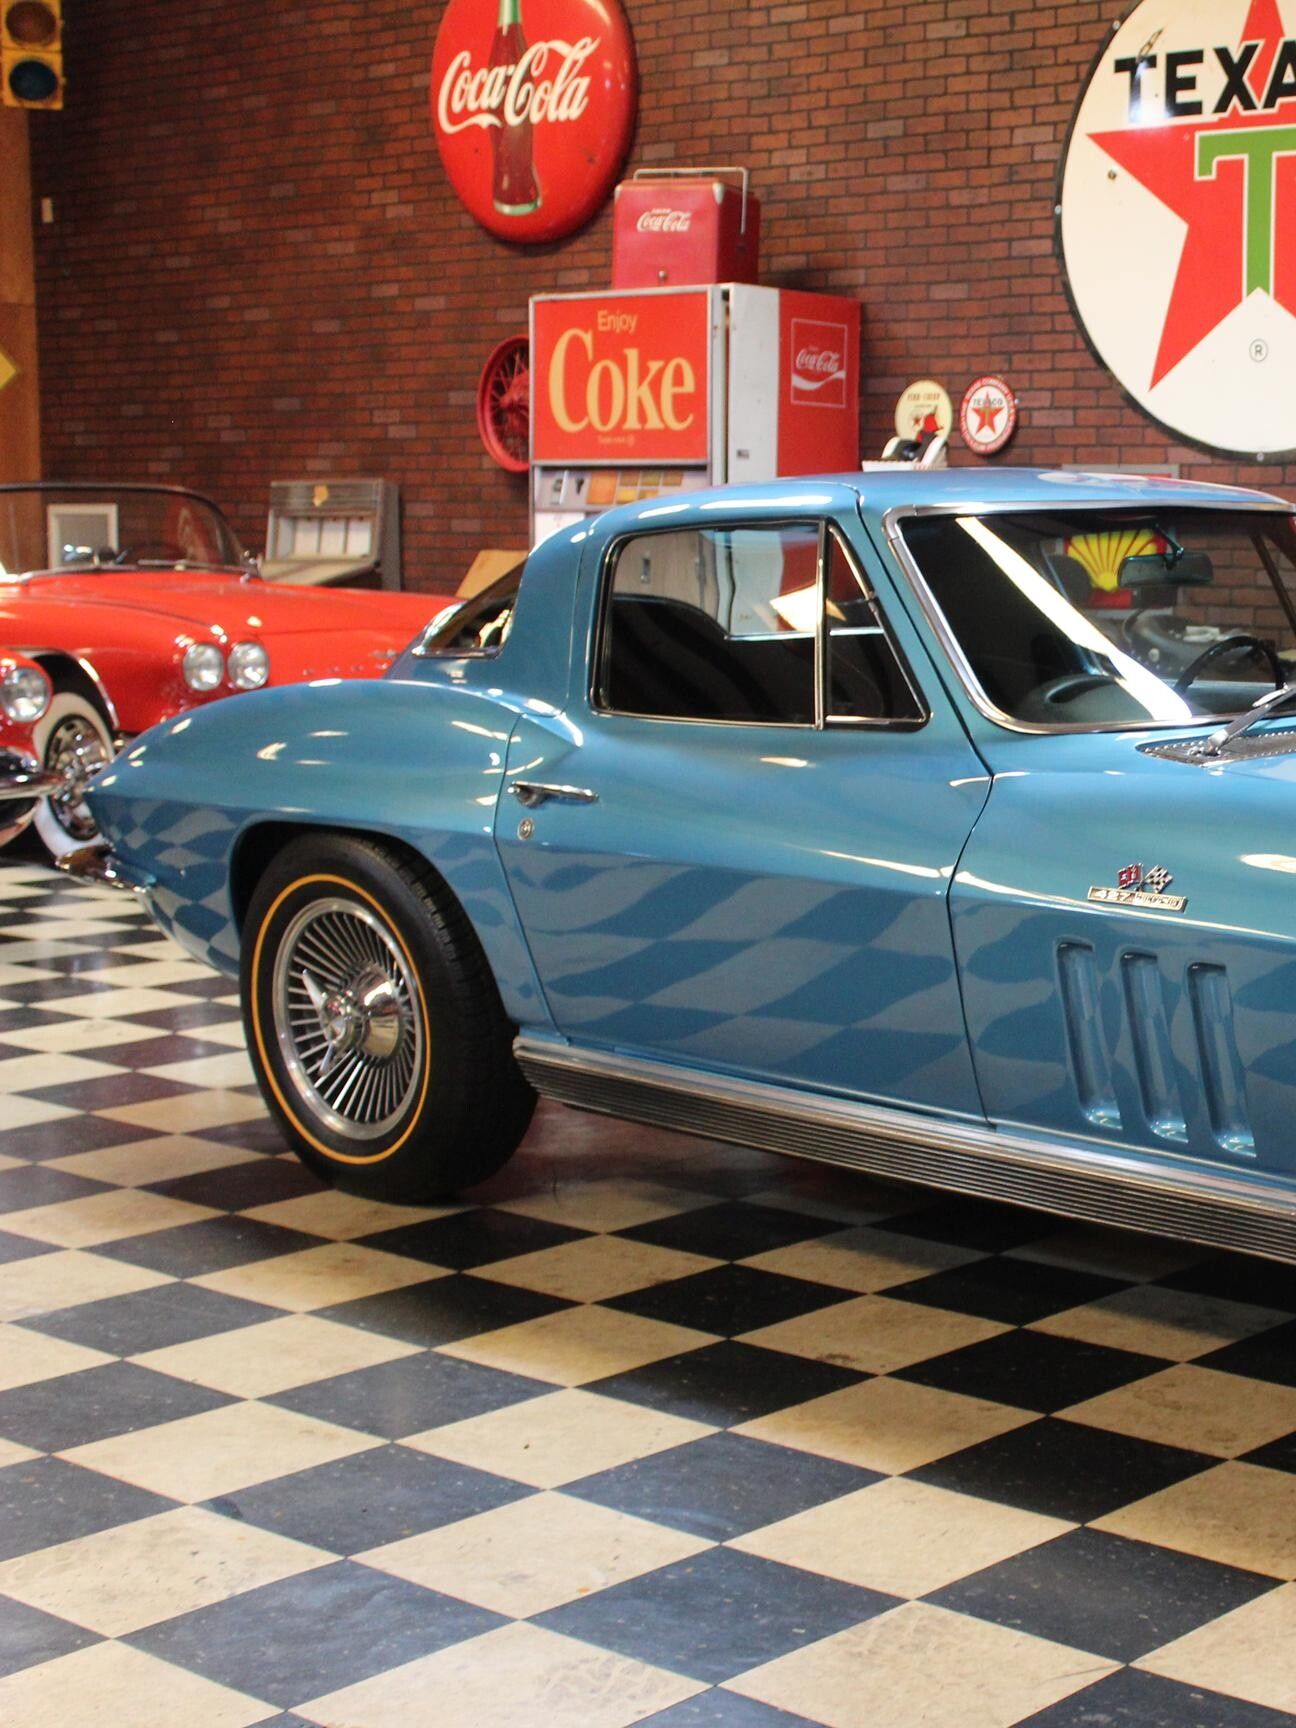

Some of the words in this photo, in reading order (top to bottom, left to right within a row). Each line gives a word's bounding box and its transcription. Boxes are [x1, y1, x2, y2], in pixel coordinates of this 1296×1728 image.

[438, 36, 601, 134] Coca-Cola
[597, 310, 638, 333] Enjoy
[549, 328, 695, 433] Coke
